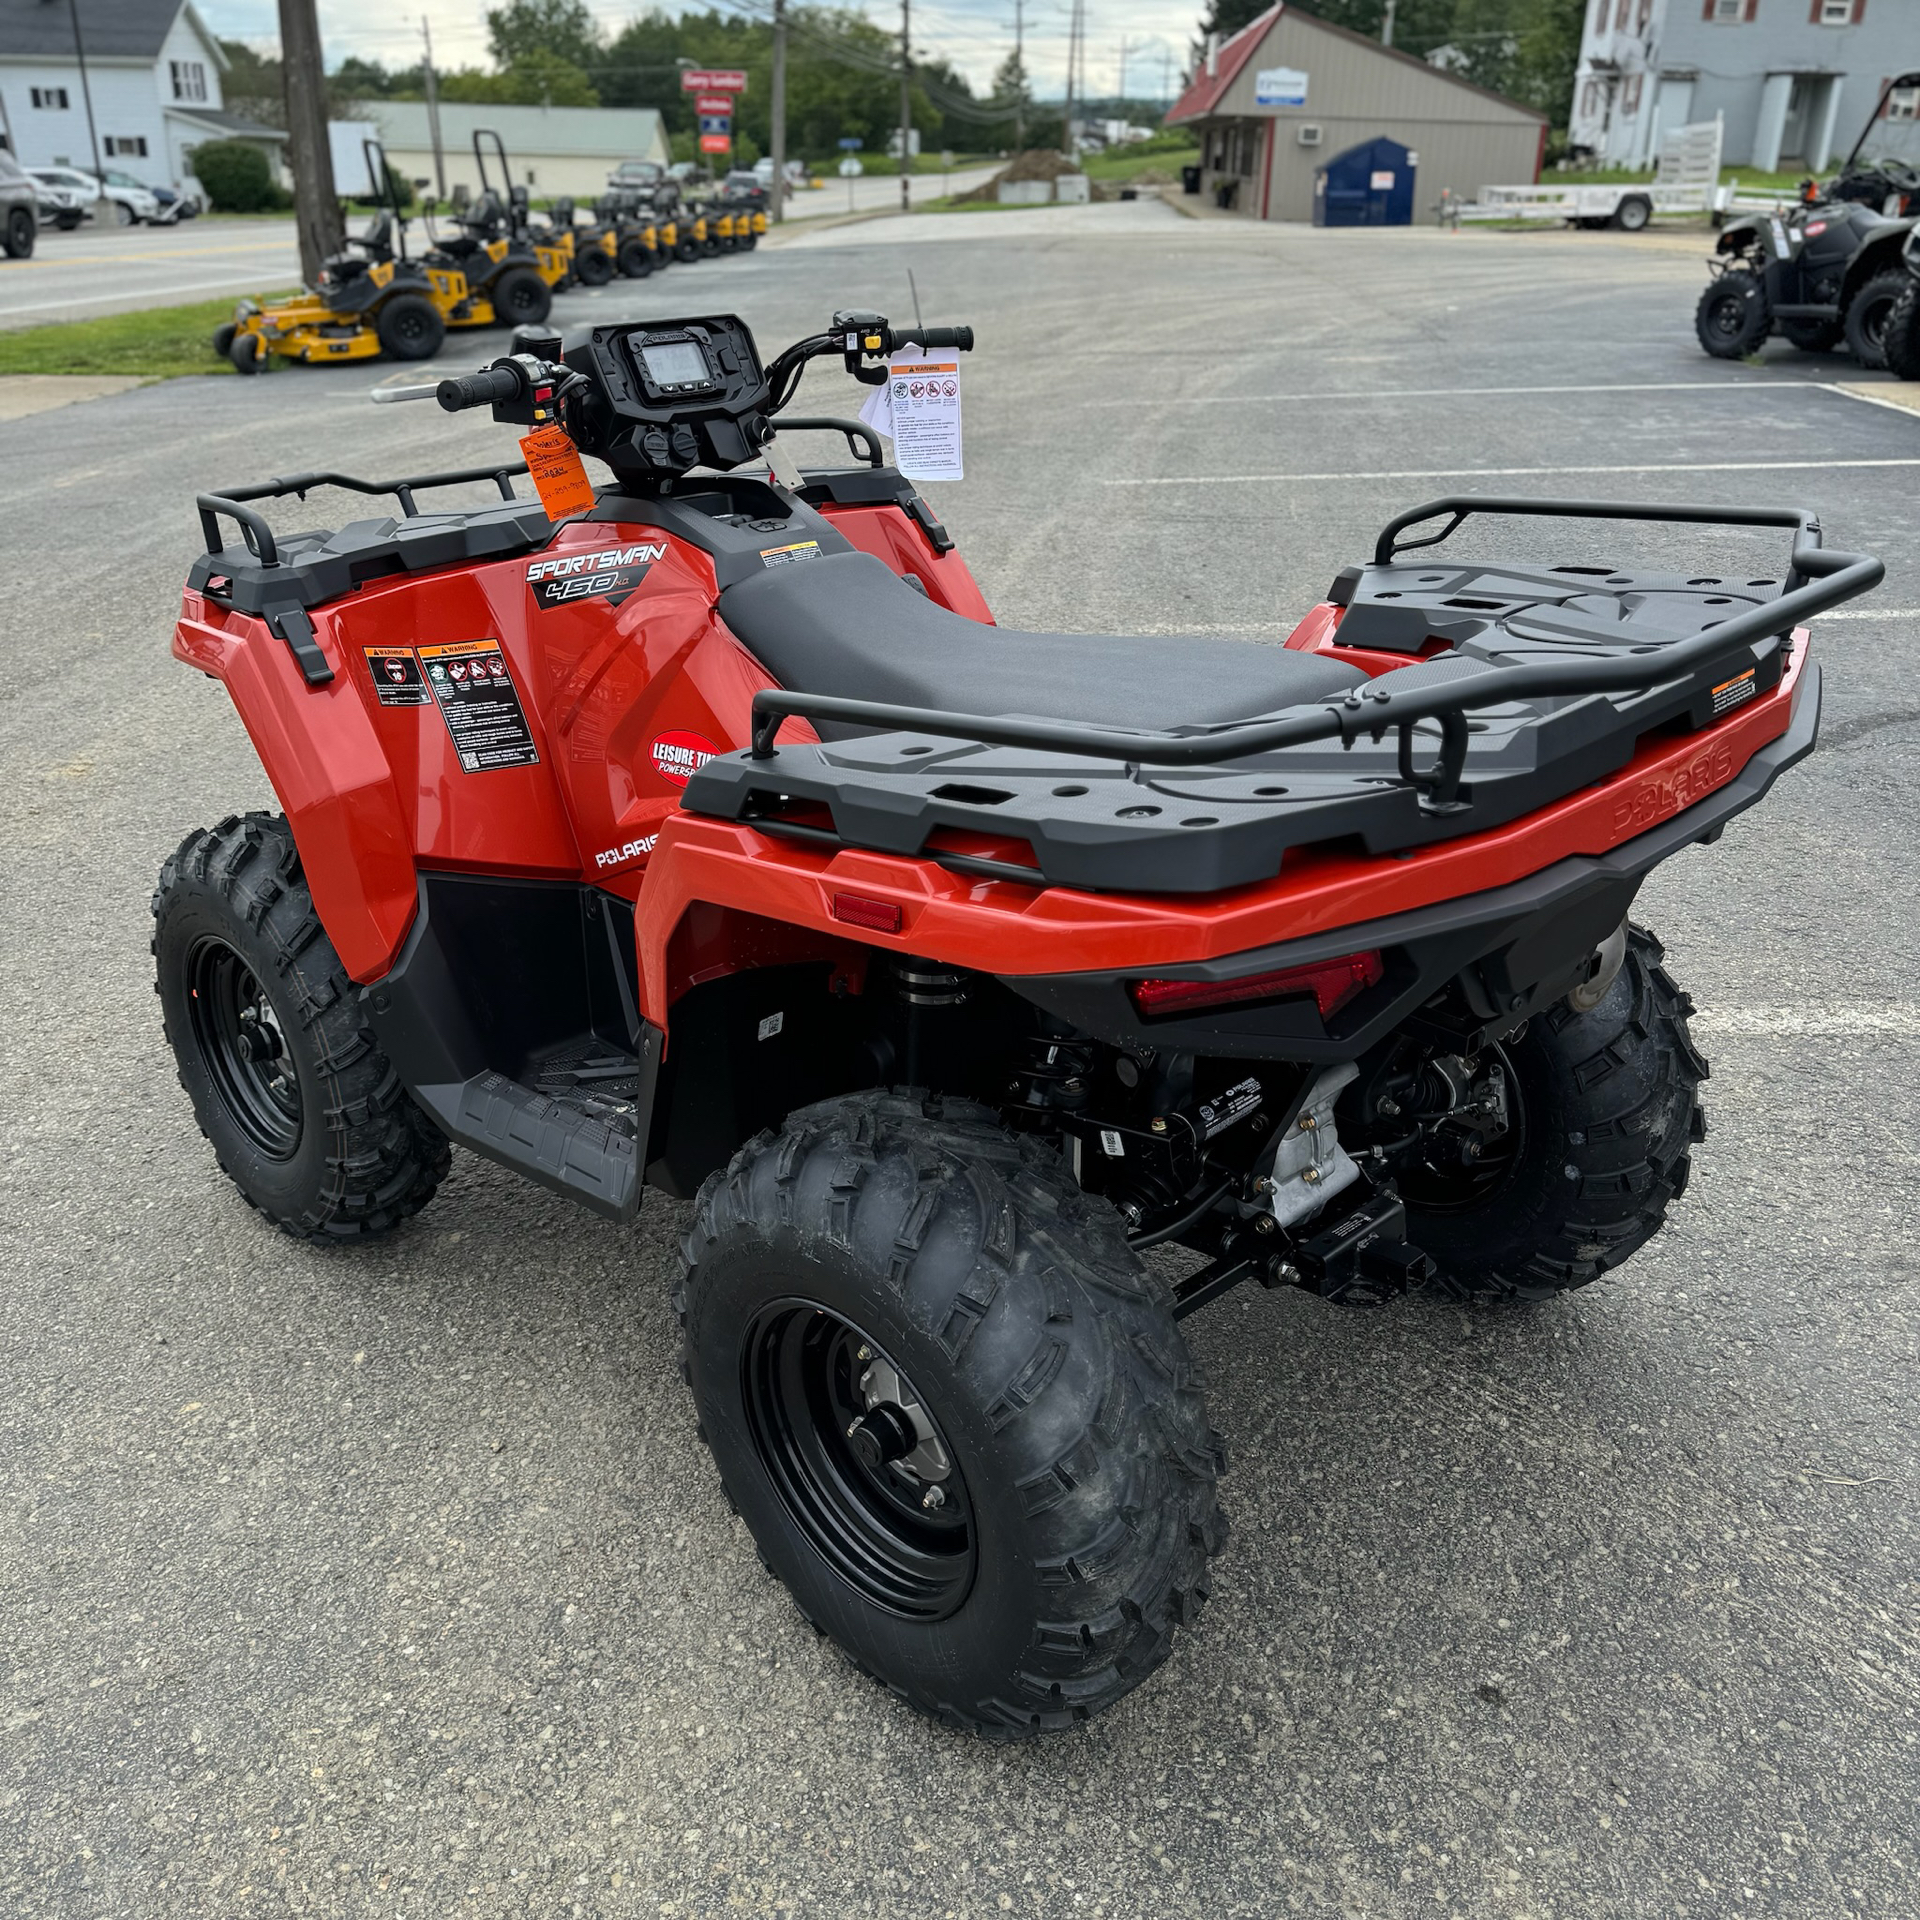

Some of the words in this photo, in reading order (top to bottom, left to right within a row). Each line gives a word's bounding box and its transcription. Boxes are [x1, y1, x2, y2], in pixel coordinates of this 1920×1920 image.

[525, 542, 669, 582] SPORTSMAN
[545, 571, 620, 600] 450
[447, 644, 478, 653] WARNING
[652, 742, 696, 766] LEISURE
[696, 751, 716, 768] TIM
[659, 761, 696, 778] POWERSP
[1610, 746, 1733, 841] POLARIS
